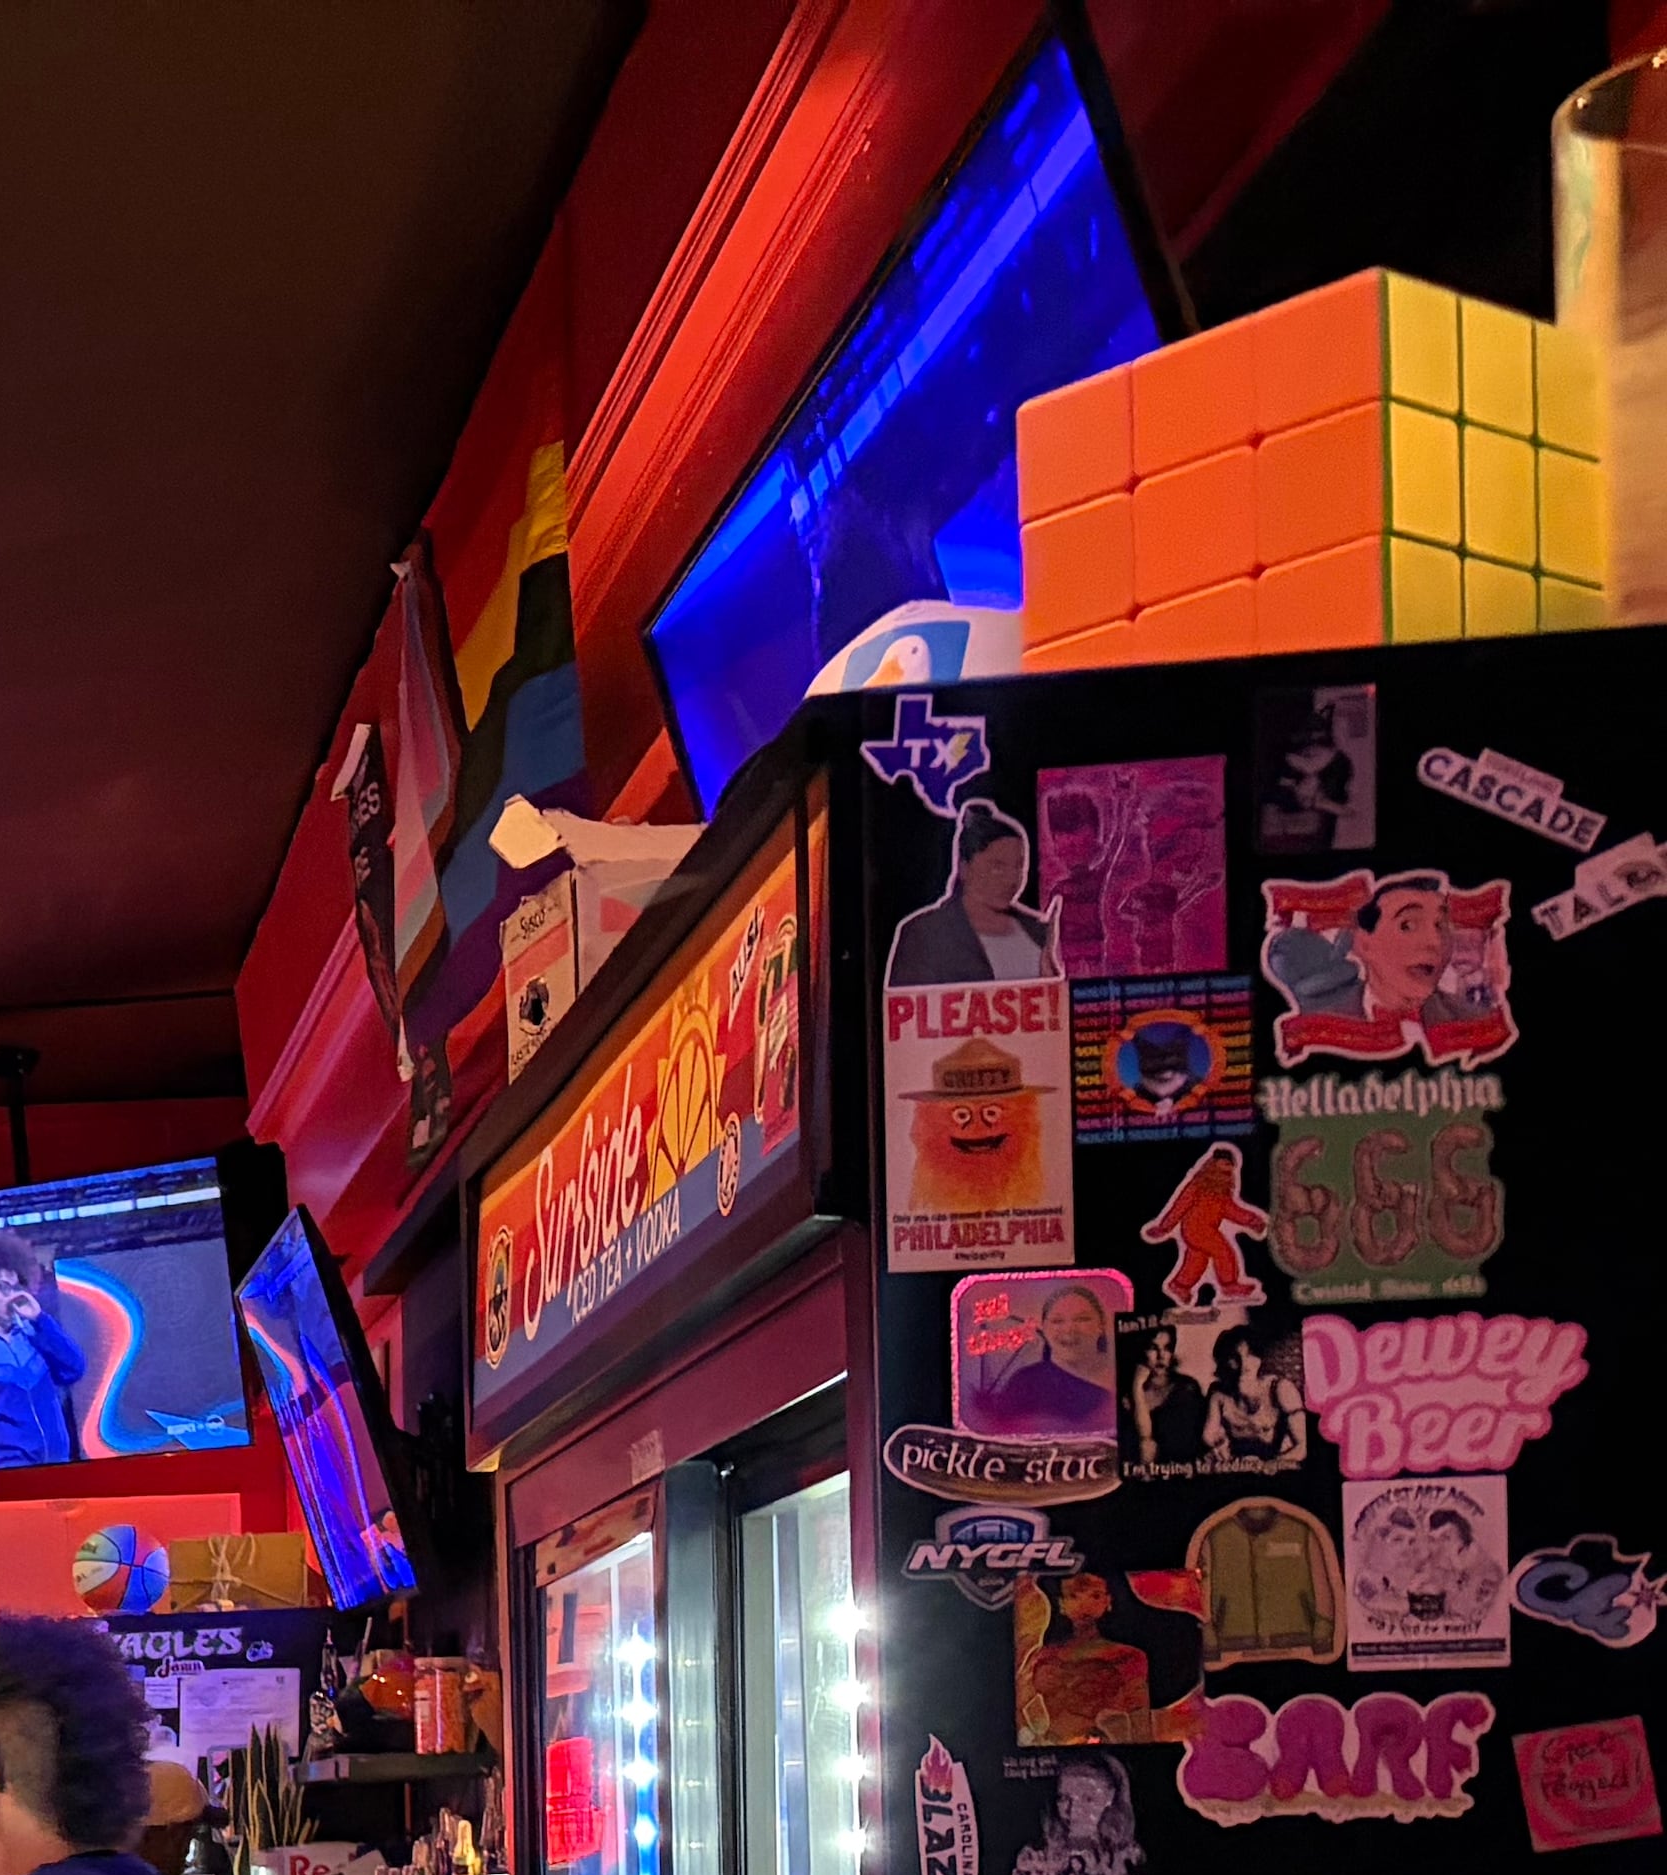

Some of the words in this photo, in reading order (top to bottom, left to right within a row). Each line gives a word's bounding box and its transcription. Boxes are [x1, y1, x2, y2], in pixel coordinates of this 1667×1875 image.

[1424, 753, 1600, 846] CASCADE
[888, 984, 1061, 1042] PLEASE!
[524, 1063, 642, 1342] Surfside
[893, 1217, 1065, 1251] PHILADELPHIA
[1273, 1123, 1499, 1273] 666
[599, 1238, 622, 1300] TEA
[635, 1187, 681, 1272] VODKA
[1303, 1313, 1586, 1402] Dewey
[902, 1438, 1006, 1482] pickle
[1344, 1392, 1548, 1474] Beer
[113, 1626, 244, 1660] AGLES
